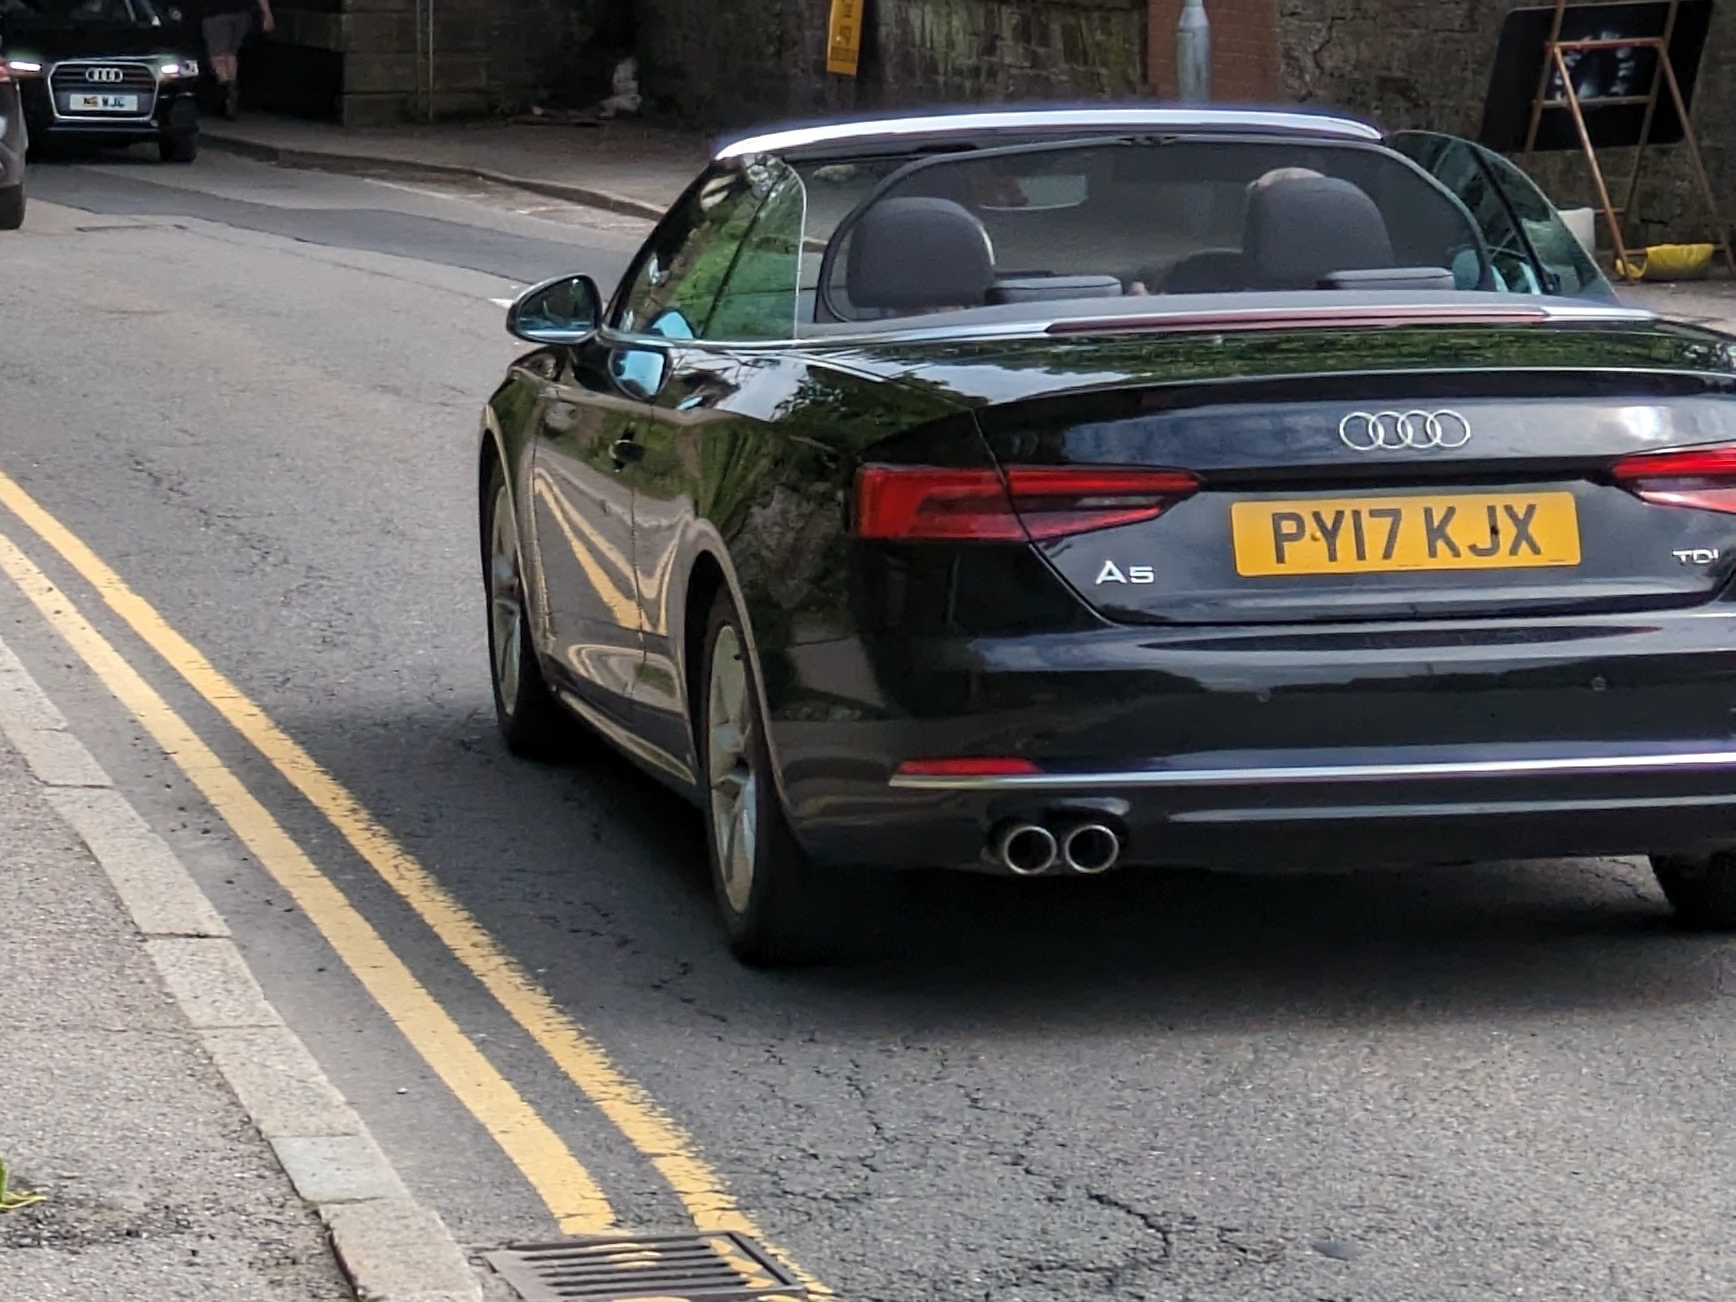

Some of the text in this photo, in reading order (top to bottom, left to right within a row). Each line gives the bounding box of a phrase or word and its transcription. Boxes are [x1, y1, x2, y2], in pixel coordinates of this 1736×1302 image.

[1271, 502, 1542, 565] PY17 KJX
[1671, 548, 1720, 565] TDI
[1094, 559, 1155, 585] A5
